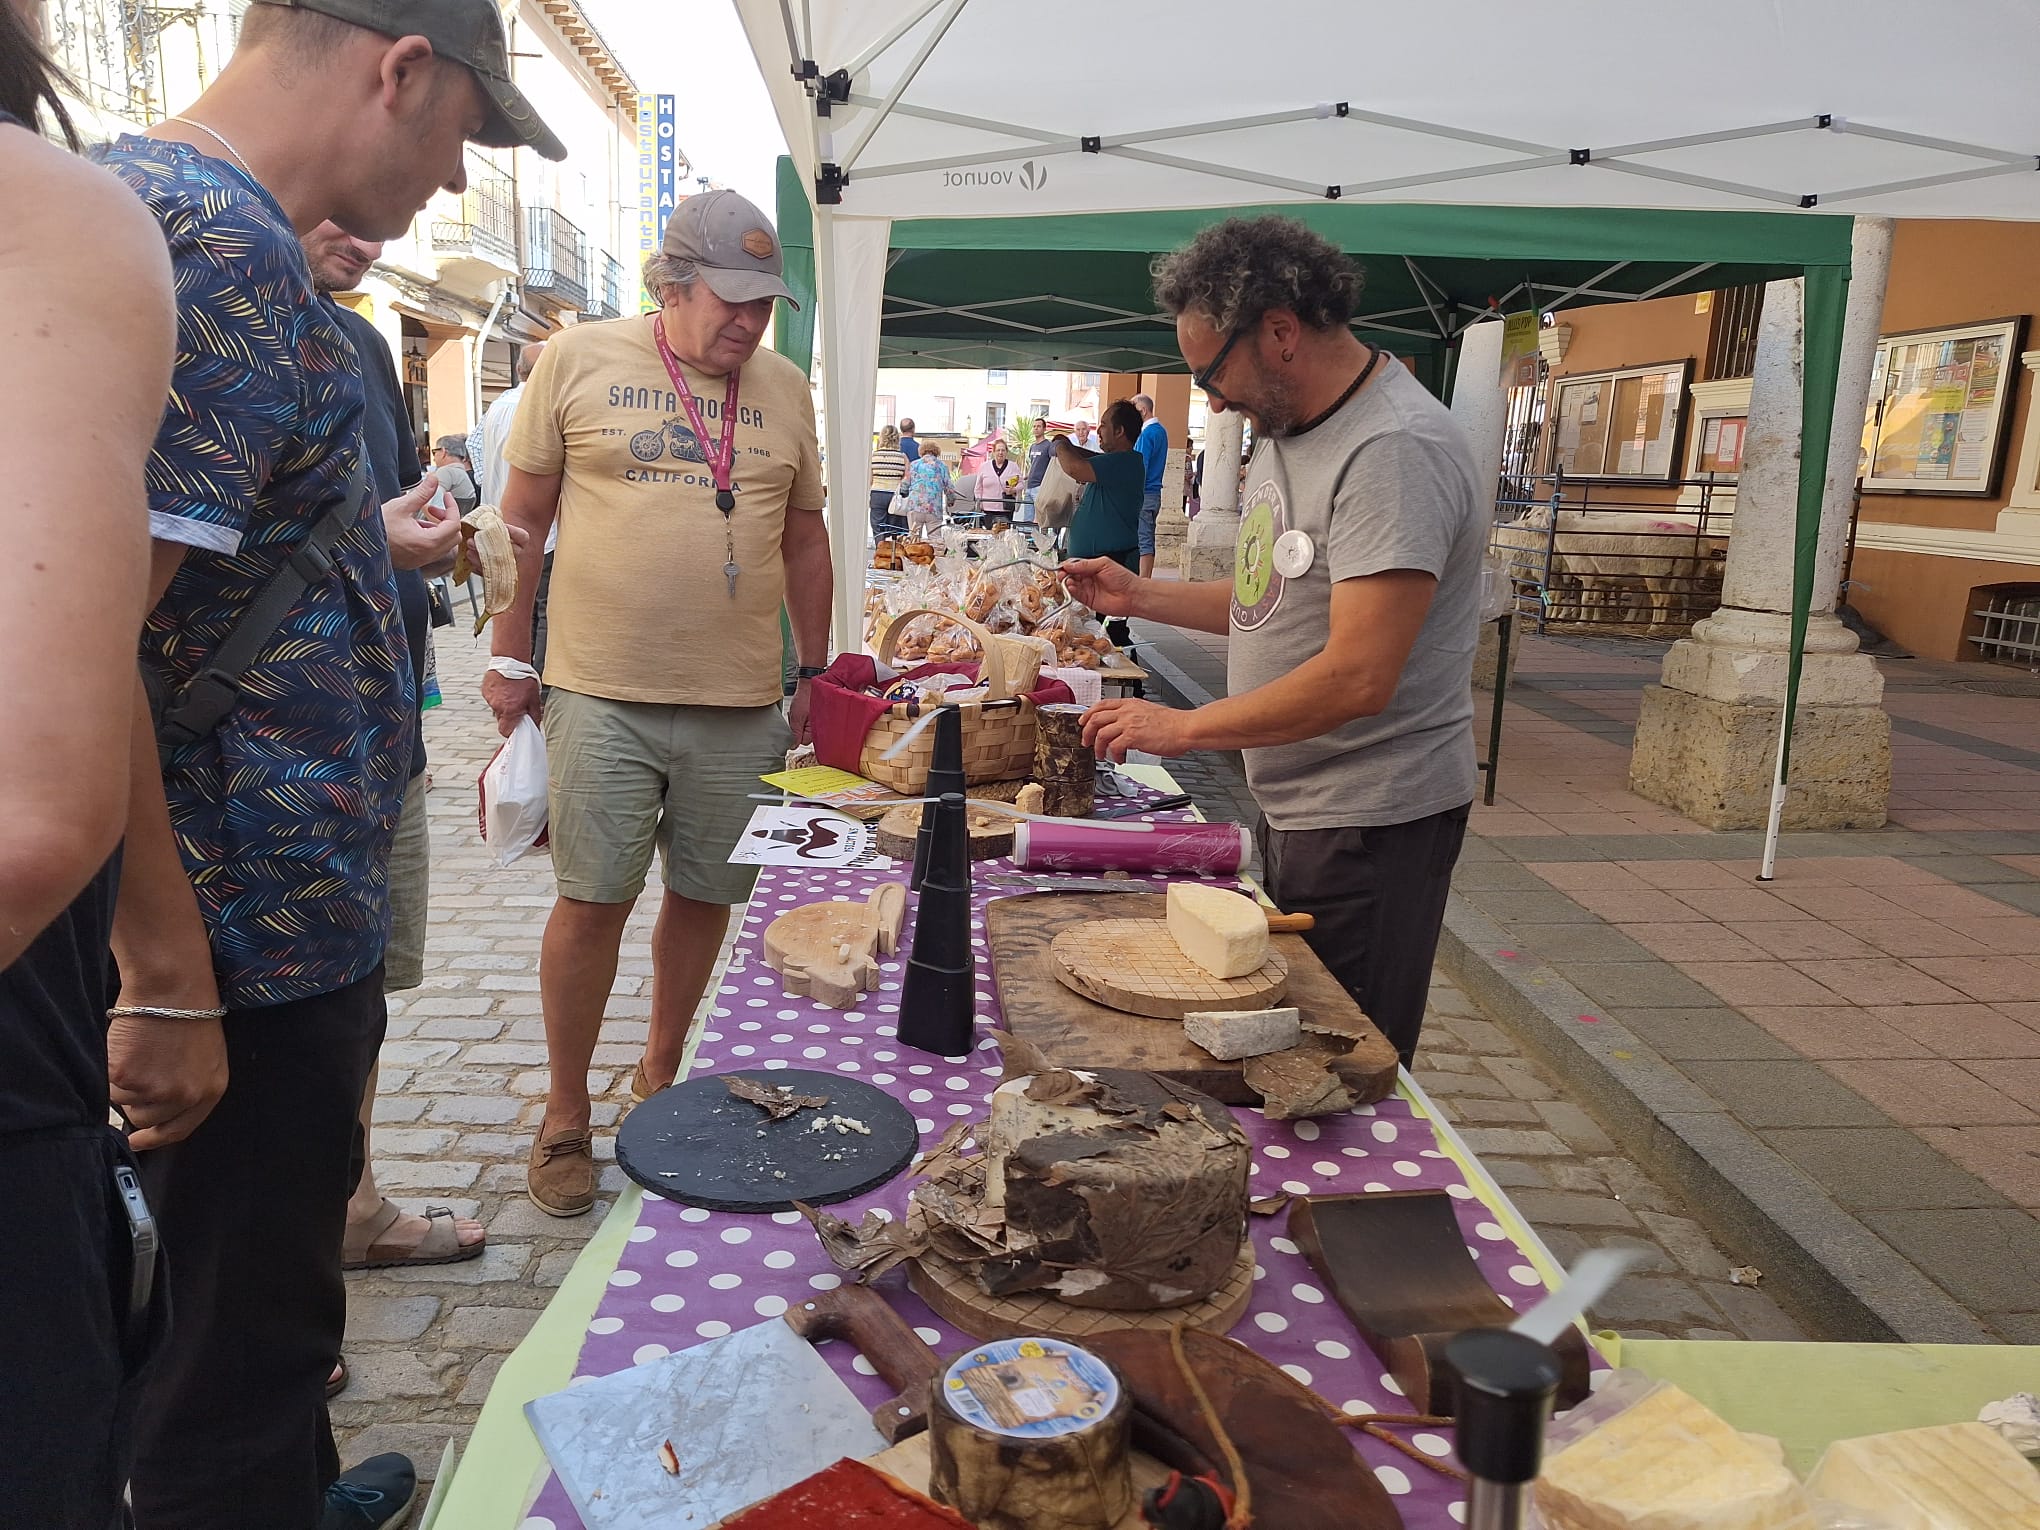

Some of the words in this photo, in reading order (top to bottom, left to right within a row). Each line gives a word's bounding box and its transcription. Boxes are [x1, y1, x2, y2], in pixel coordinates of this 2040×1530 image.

[639, 96, 653, 250] restaurante
[608, 385, 677, 413] SANTA
[601, 428, 627, 436] EST.
[747, 447, 772, 458] 1968
[625, 469, 742, 493] CALIFORNA
